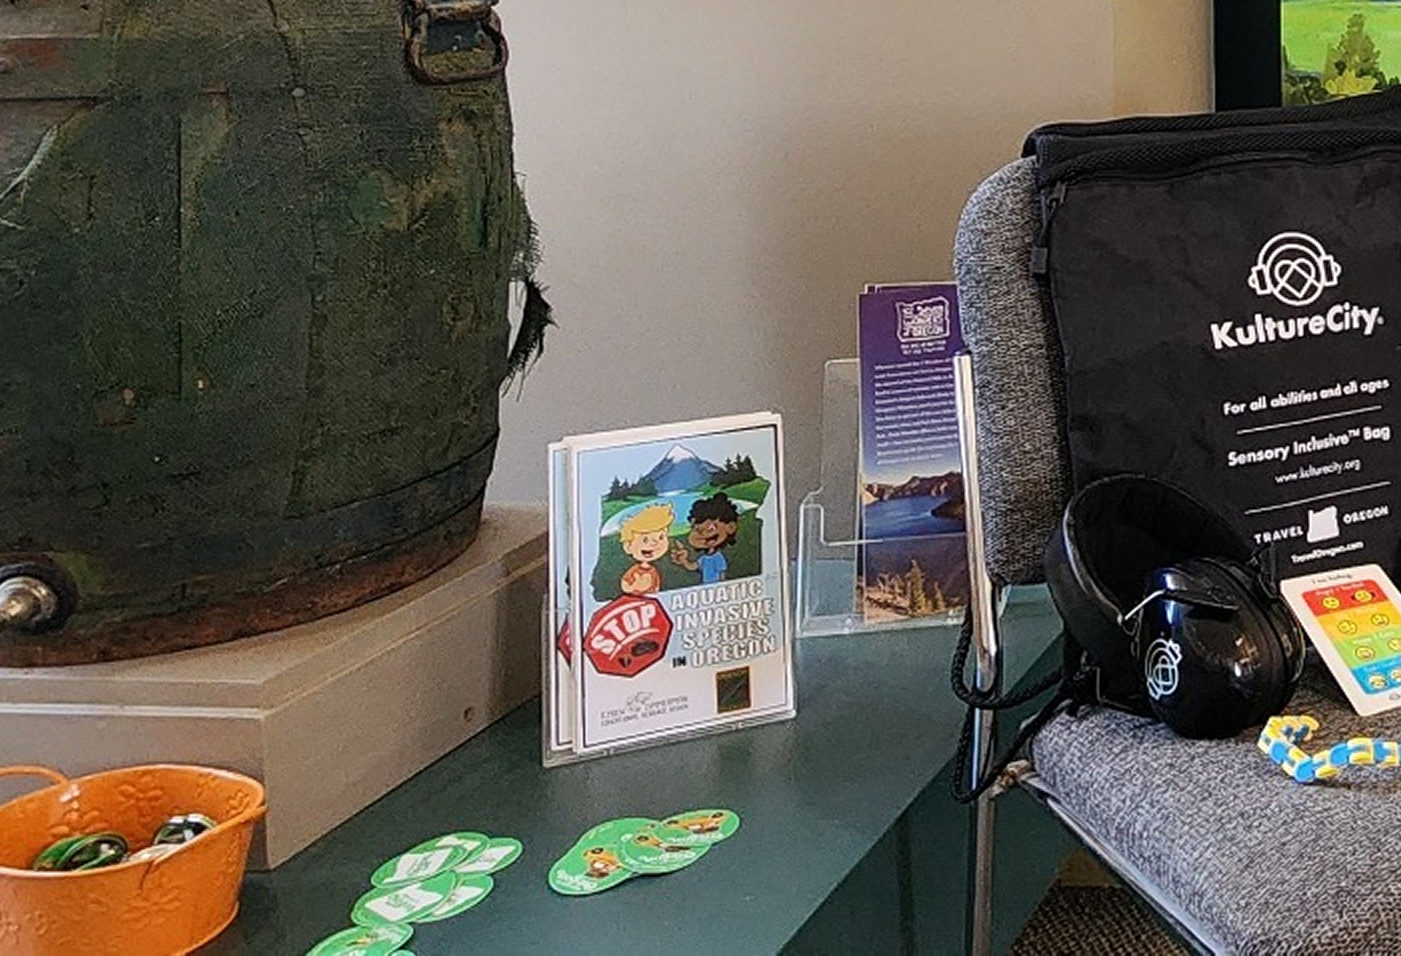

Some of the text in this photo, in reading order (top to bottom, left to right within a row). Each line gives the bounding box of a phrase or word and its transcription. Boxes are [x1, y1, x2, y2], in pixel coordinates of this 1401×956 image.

[1223, 401, 1246, 416] For
[1249, 395, 1267, 411] all
[1270, 387, 1318, 408] abilities
[1320, 383, 1341, 400] and
[1360, 378, 1390, 395] ages
[1228, 444, 1290, 467] Sensory
[1363, 425, 1391, 443] Bag
[1254, 506, 1389, 544] TRAVEL OREGON
[670, 578, 763, 610] AQUATIC
[590, 600, 657, 656] STOP
[675, 598, 775, 631] INVASIVE
[672, 635, 777, 668] IN OREGON
[682, 619, 771, 649] SPECIES
